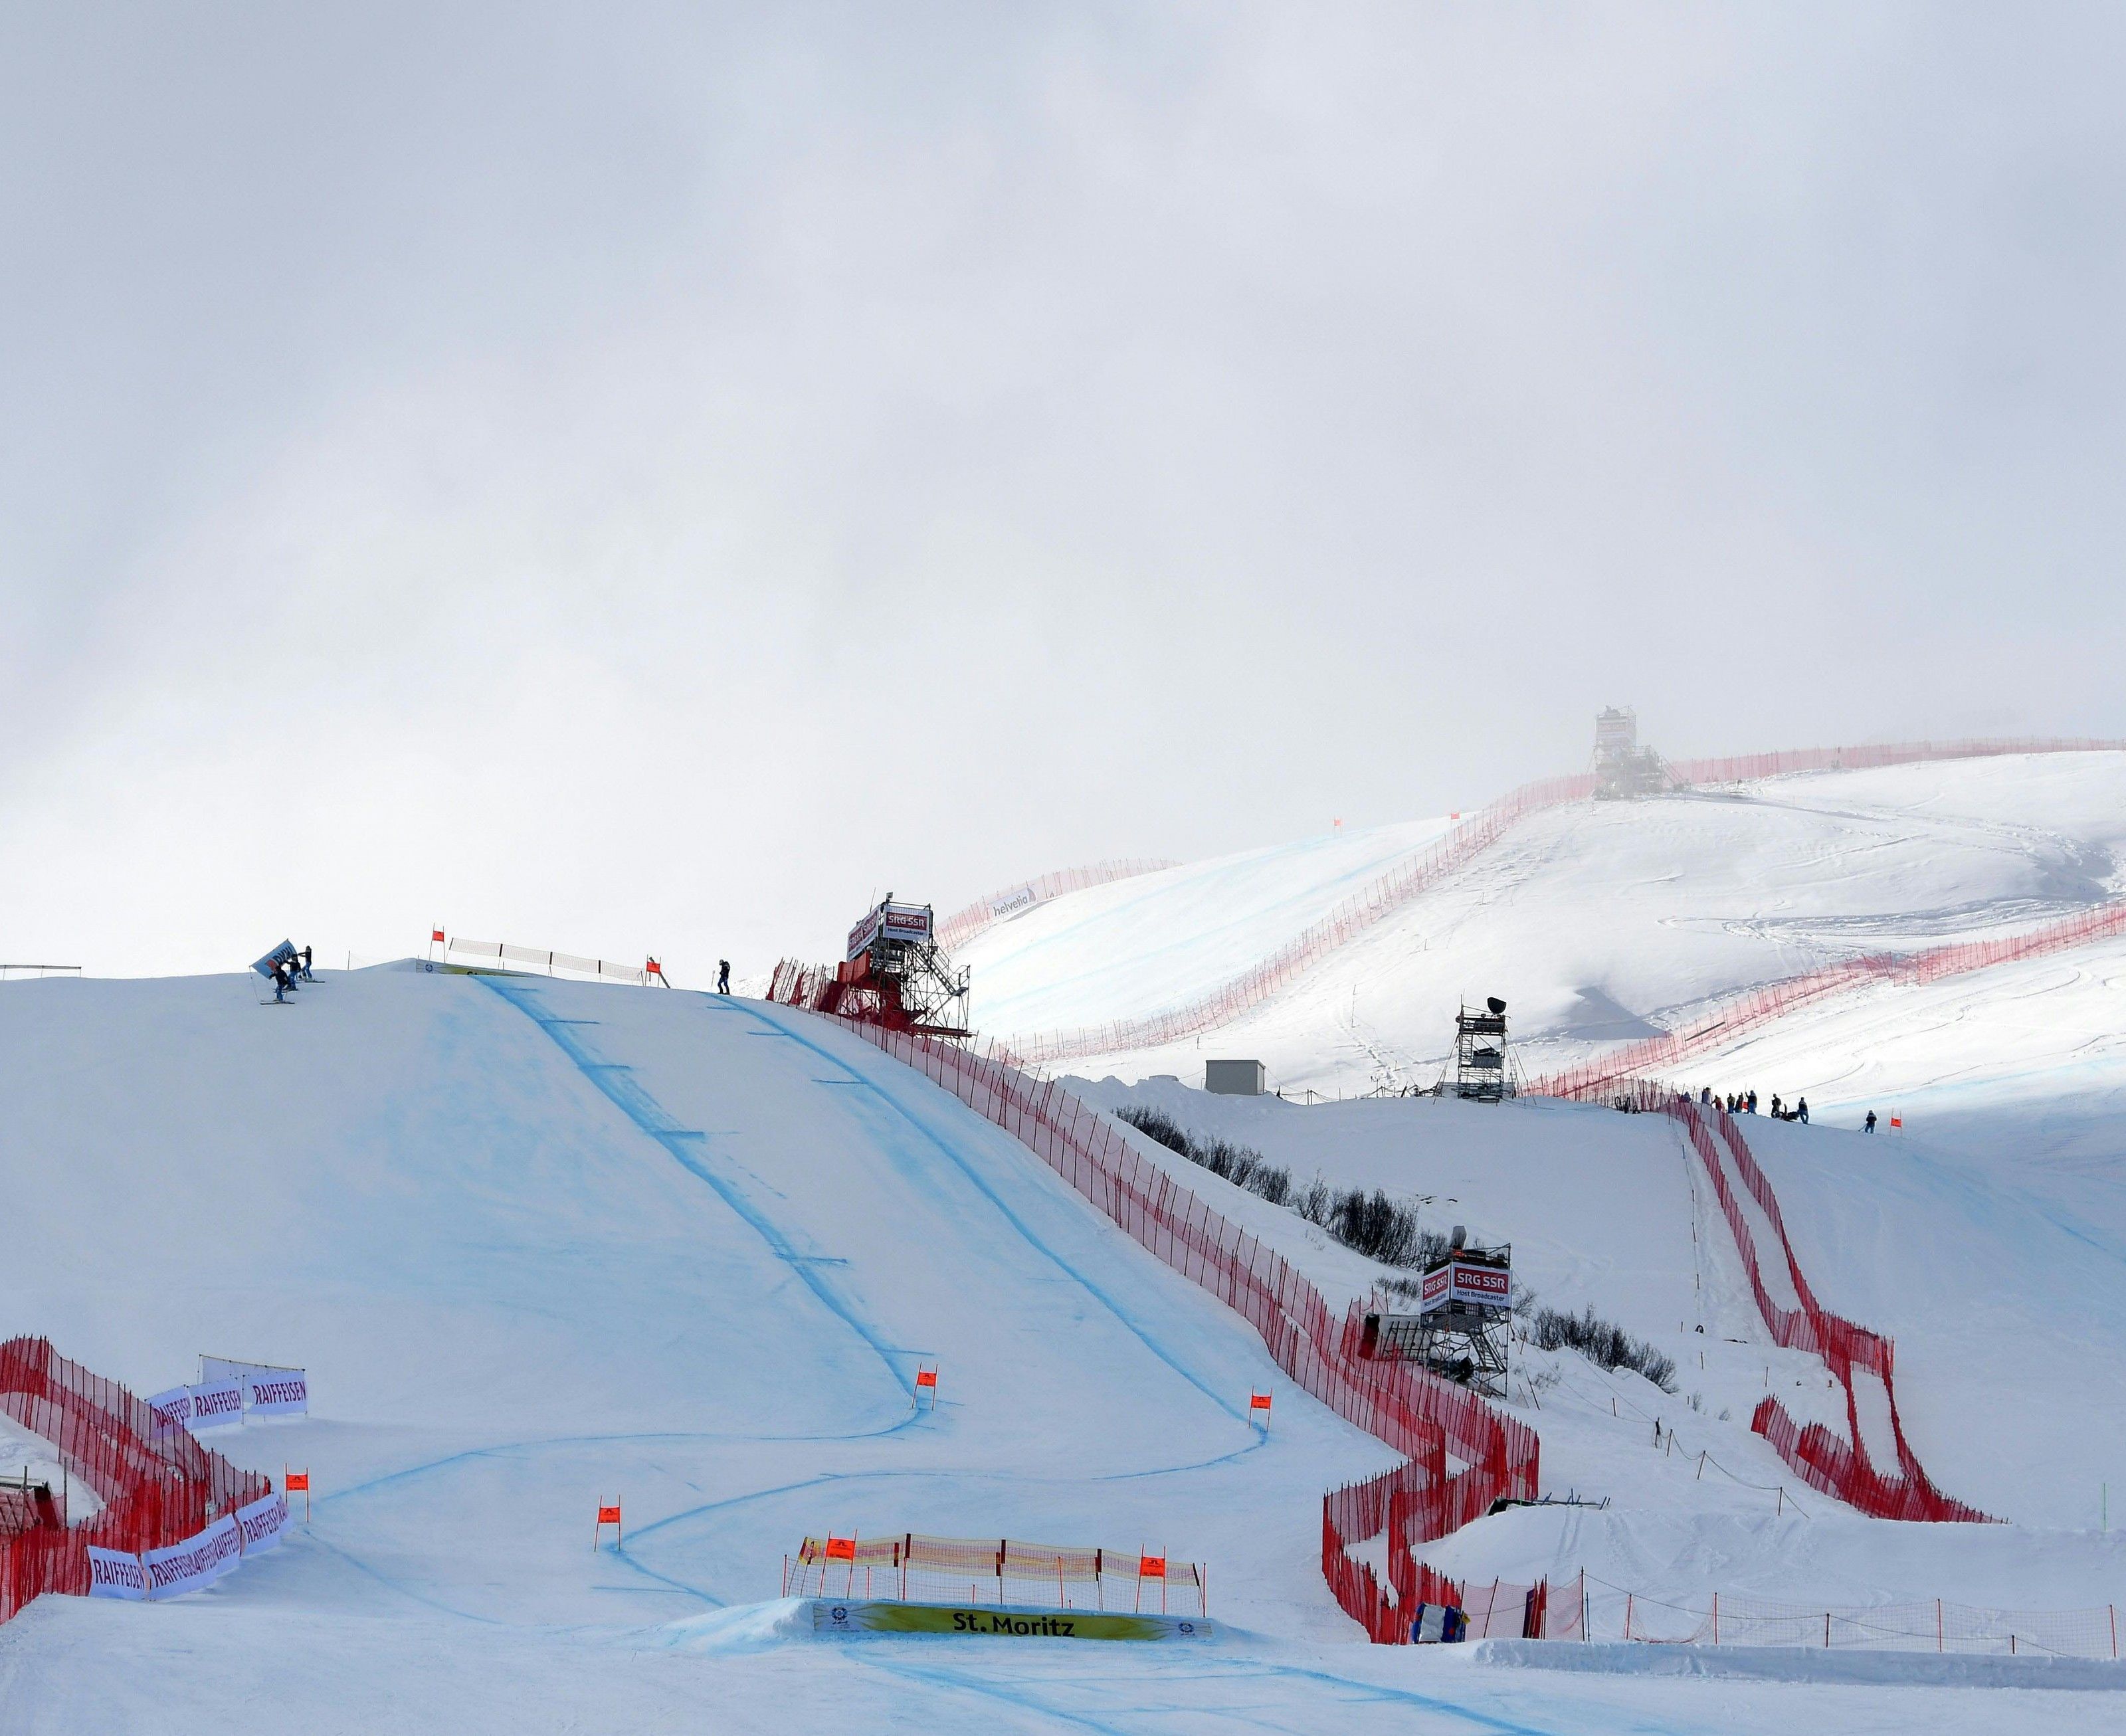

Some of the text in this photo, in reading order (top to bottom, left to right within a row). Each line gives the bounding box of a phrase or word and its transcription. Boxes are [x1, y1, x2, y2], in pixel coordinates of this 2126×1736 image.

[993, 896, 1028, 916] helvetia
[888, 916, 925, 927] SRG SSR
[1424, 1281, 1436, 1296] SRG
[1457, 1272, 1505, 1290] SRG SSR
[1471, 1292, 1505, 1302] Broadcaster
[252, 1381, 307, 1405] RAIFFEISEN
[195, 1390, 242, 1418] RAIFFEISEN
[92, 1559, 145, 1591] RAIFFEISEN
[953, 1612, 1076, 1637] St. Moritz
